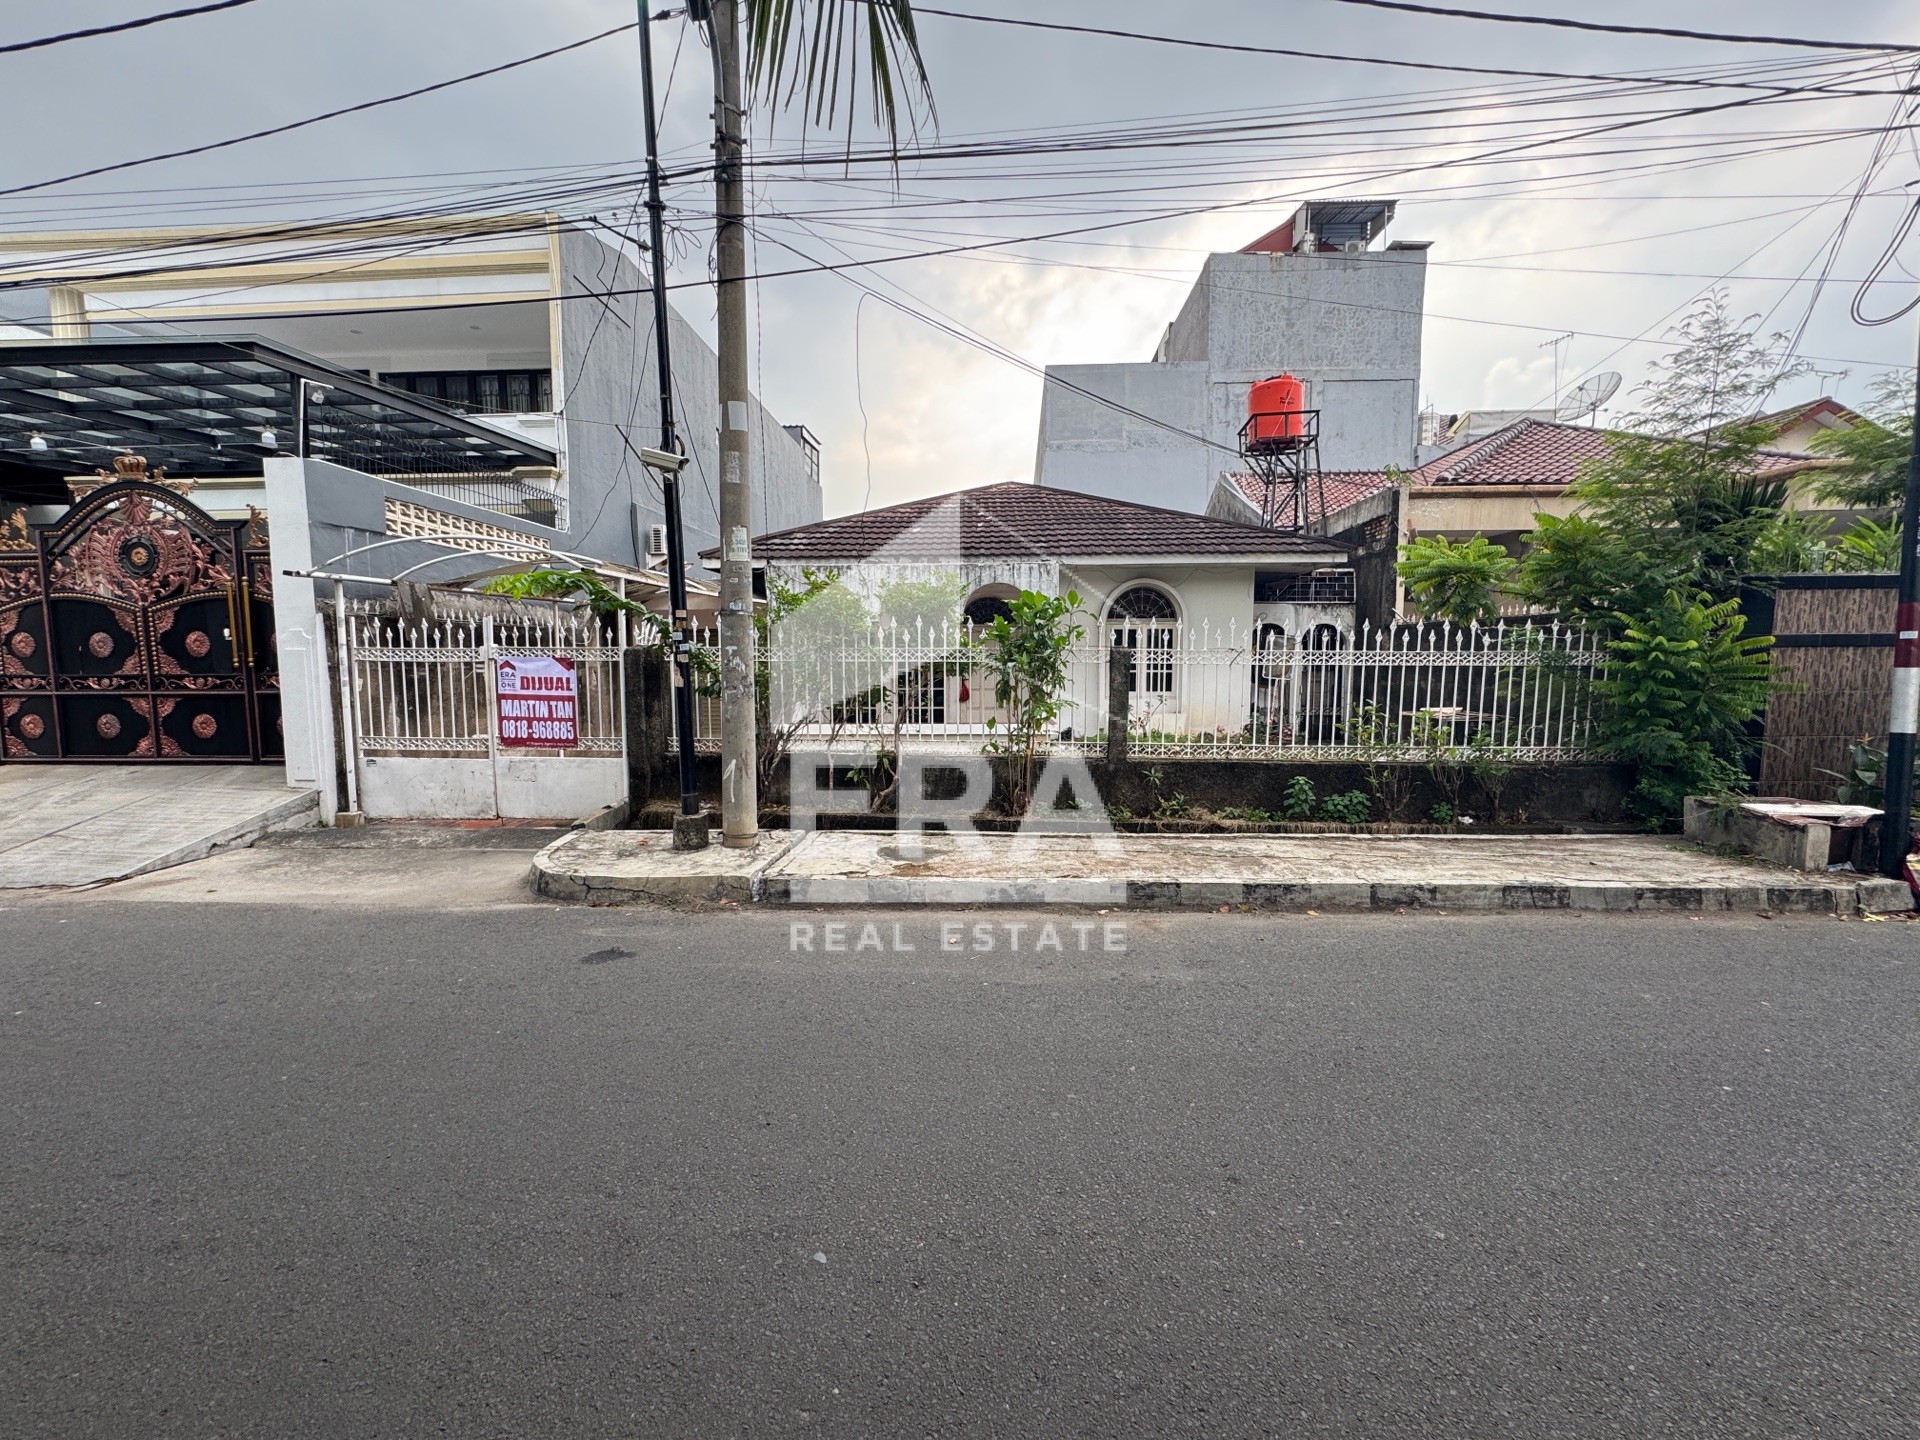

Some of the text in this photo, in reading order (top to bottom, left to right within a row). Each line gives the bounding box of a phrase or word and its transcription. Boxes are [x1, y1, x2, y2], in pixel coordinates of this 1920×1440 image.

[520, 676, 573, 691] DIJUAL
[501, 699, 573, 718] MARTIN TAN
[502, 719, 574, 739] 0818-968885
